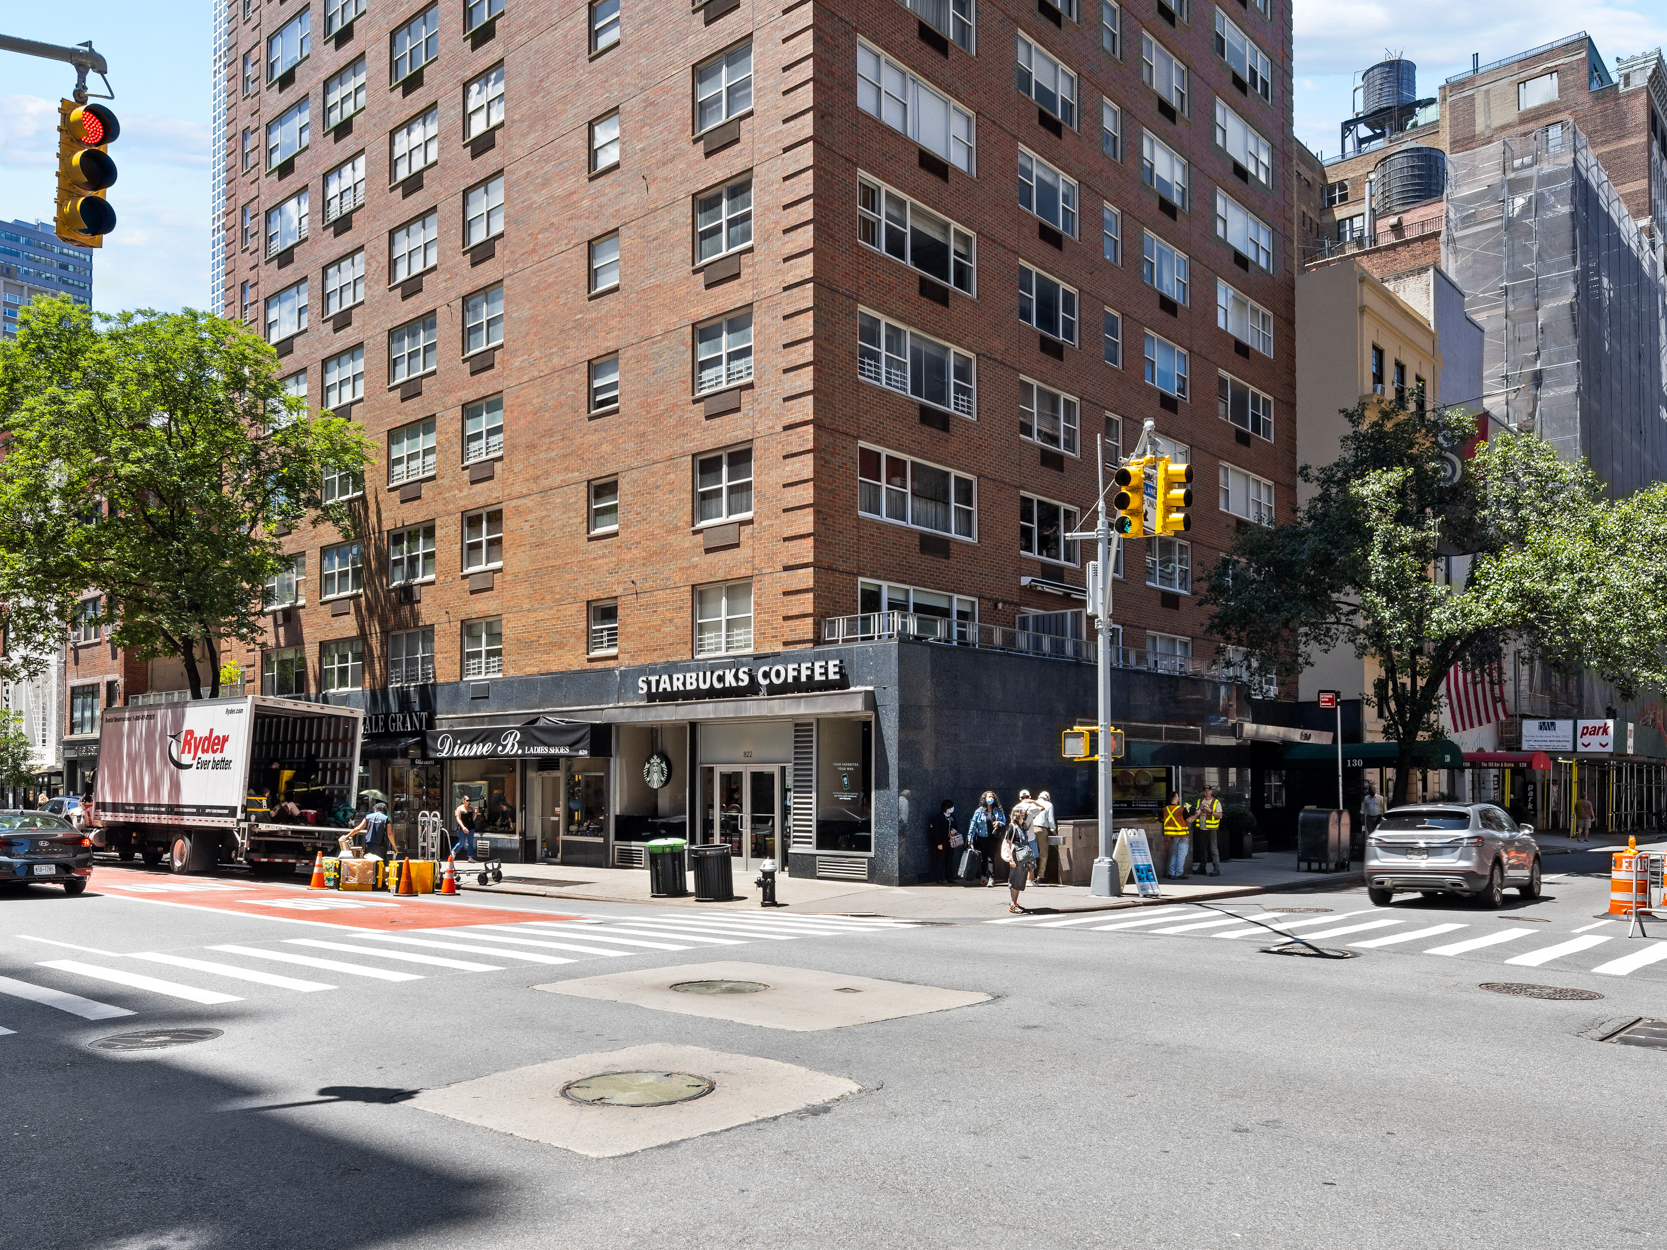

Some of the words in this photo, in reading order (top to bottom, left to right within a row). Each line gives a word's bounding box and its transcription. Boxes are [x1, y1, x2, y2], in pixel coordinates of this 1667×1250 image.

[638, 667, 750, 694] STARBUCKS
[758, 659, 841, 685] COFFEE
[225, 708, 244, 716] Ryder.com
[388, 711, 428, 733] GRANT
[1580, 722, 1611, 739] park
[181, 728, 230, 761] Ryder
[436, 733, 497, 757] Diane
[497, 729, 522, 755] B.
[525, 745, 549, 754] LADIES
[549, 745, 570, 754] SHOES
[743, 750, 753, 758] 822
[196, 757, 210, 770] Ever
[211, 757, 233, 770] better.
[1346, 758, 1363, 768] 130
